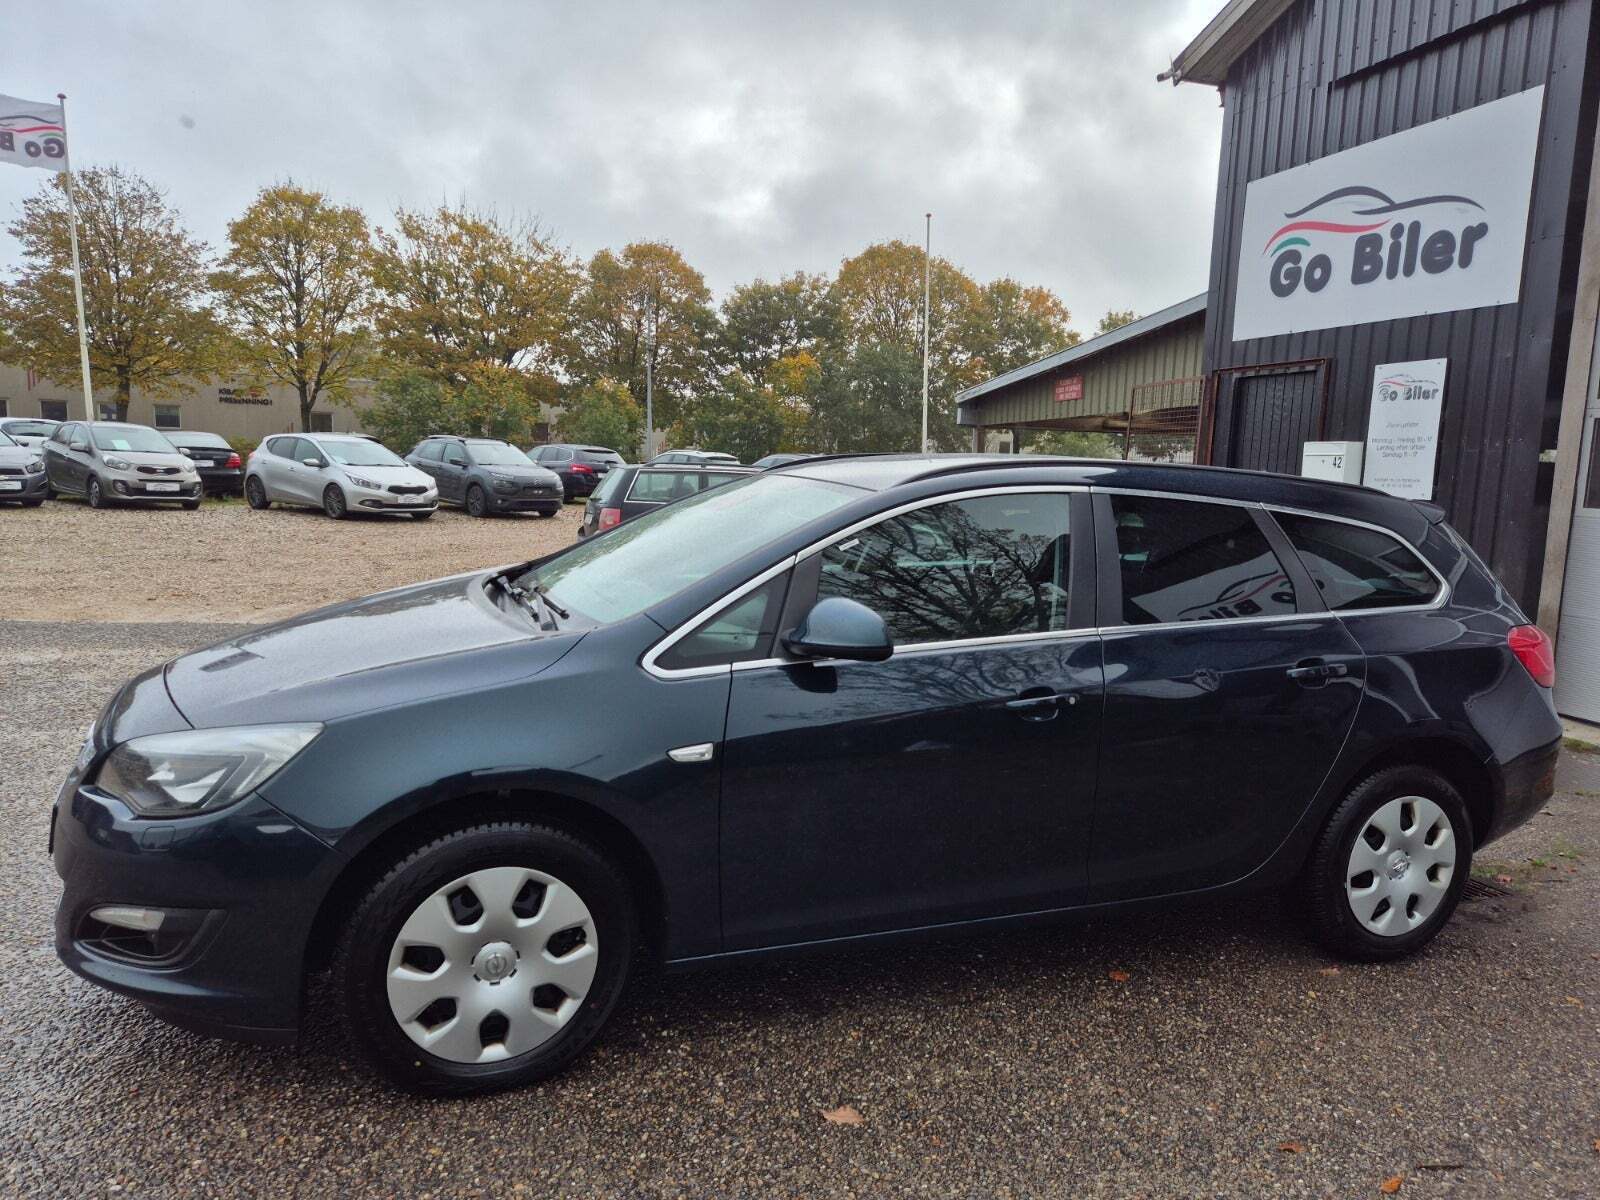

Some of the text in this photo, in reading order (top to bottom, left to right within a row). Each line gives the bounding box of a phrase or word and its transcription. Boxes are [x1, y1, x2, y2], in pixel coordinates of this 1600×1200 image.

[1269, 220, 1489, 298] Go Biler
[1379, 385, 1439, 401] Go Biler
[1332, 456, 1344, 469] 42
